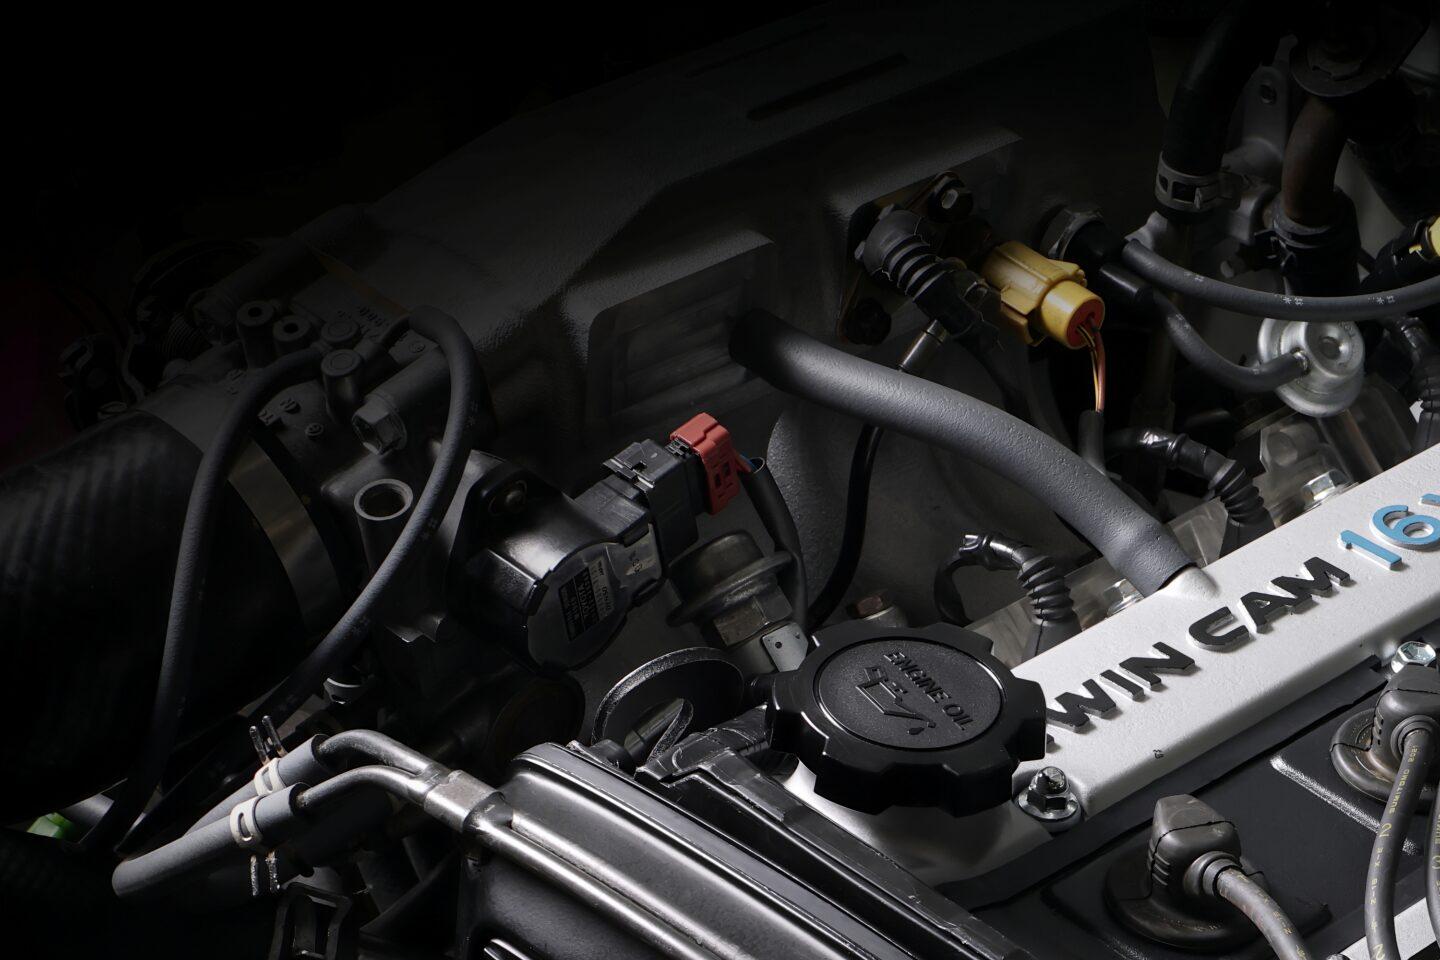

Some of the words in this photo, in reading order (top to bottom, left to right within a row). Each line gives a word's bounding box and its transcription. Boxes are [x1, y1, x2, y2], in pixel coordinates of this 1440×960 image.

[1189, 557, 1350, 653] CAM
[883, 651, 952, 704] ENGINE
[942, 702, 973, 731] OIL
[1379, 823, 1392, 837] 2
[1389, 769, 1410, 814] SUMITOMO
